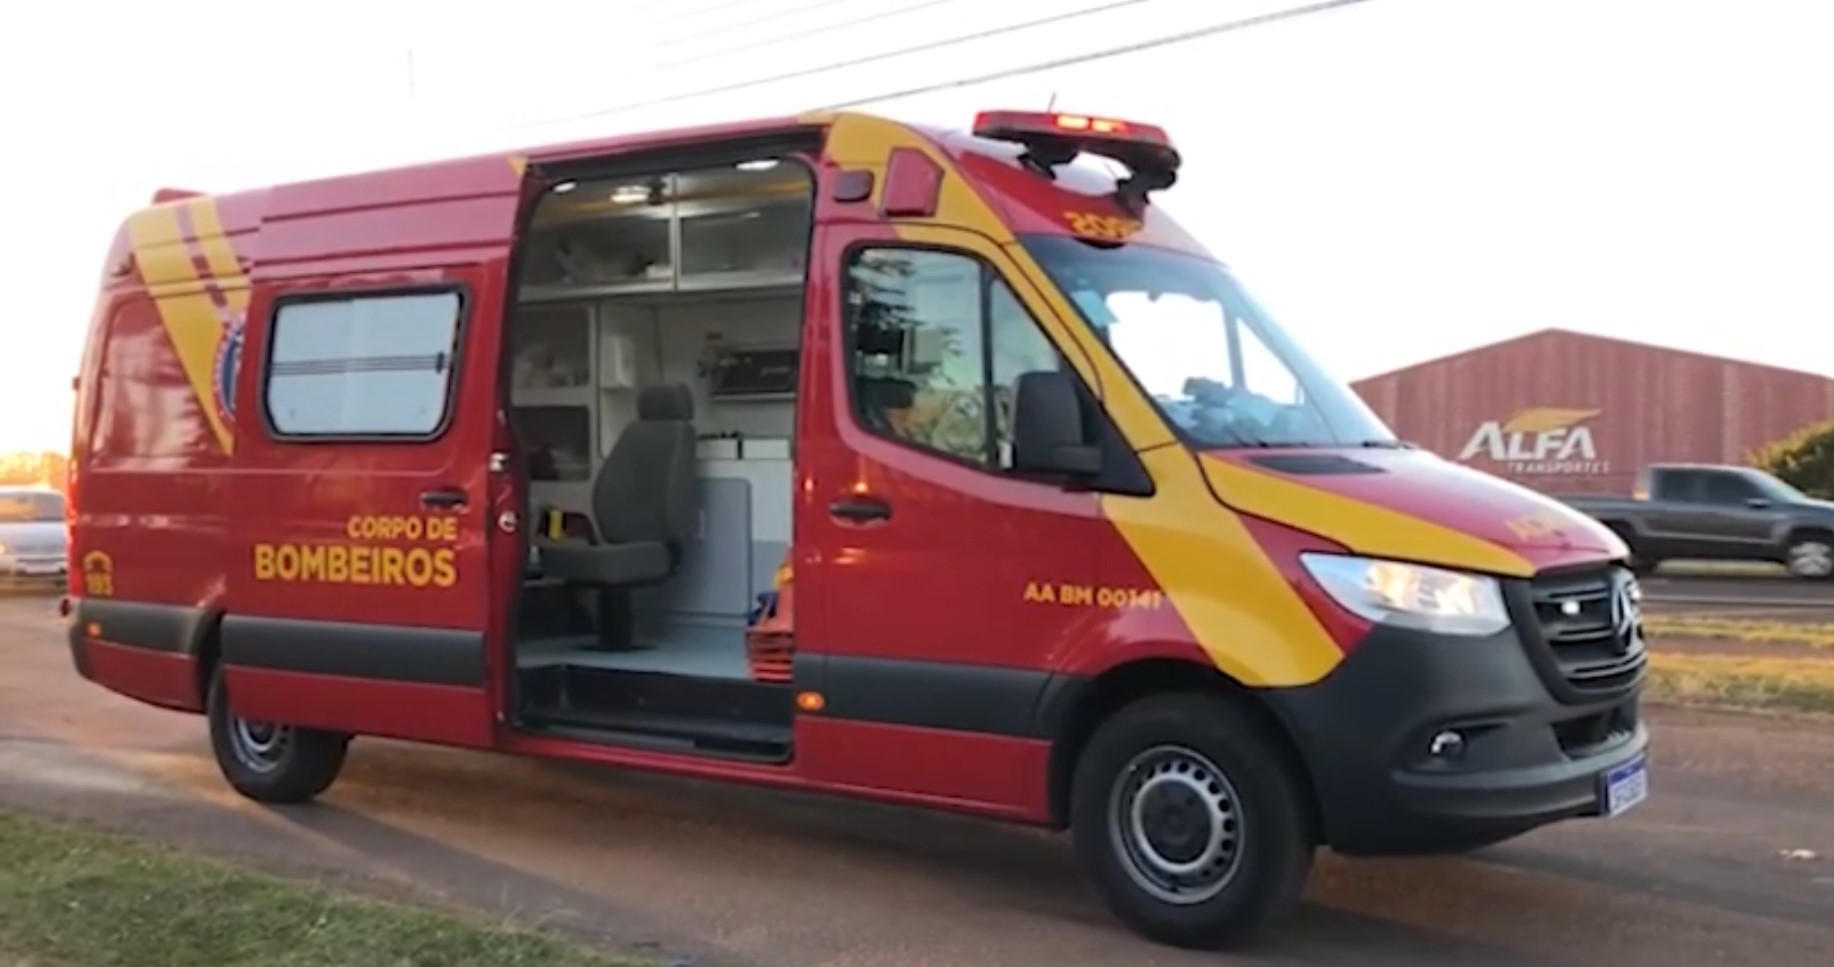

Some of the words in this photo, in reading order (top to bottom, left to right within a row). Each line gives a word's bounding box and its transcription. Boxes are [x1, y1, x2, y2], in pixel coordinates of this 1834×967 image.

[1457, 420, 1597, 461] ALFA
[1507, 461, 1610, 475] TRANSPORTES
[347, 515, 422, 540] CORPO
[426, 516, 458, 540] DE
[254, 543, 456, 587] BOMBEIROS
[1024, 582, 1056, 602] AA
[1060, 584, 1094, 605] BM
